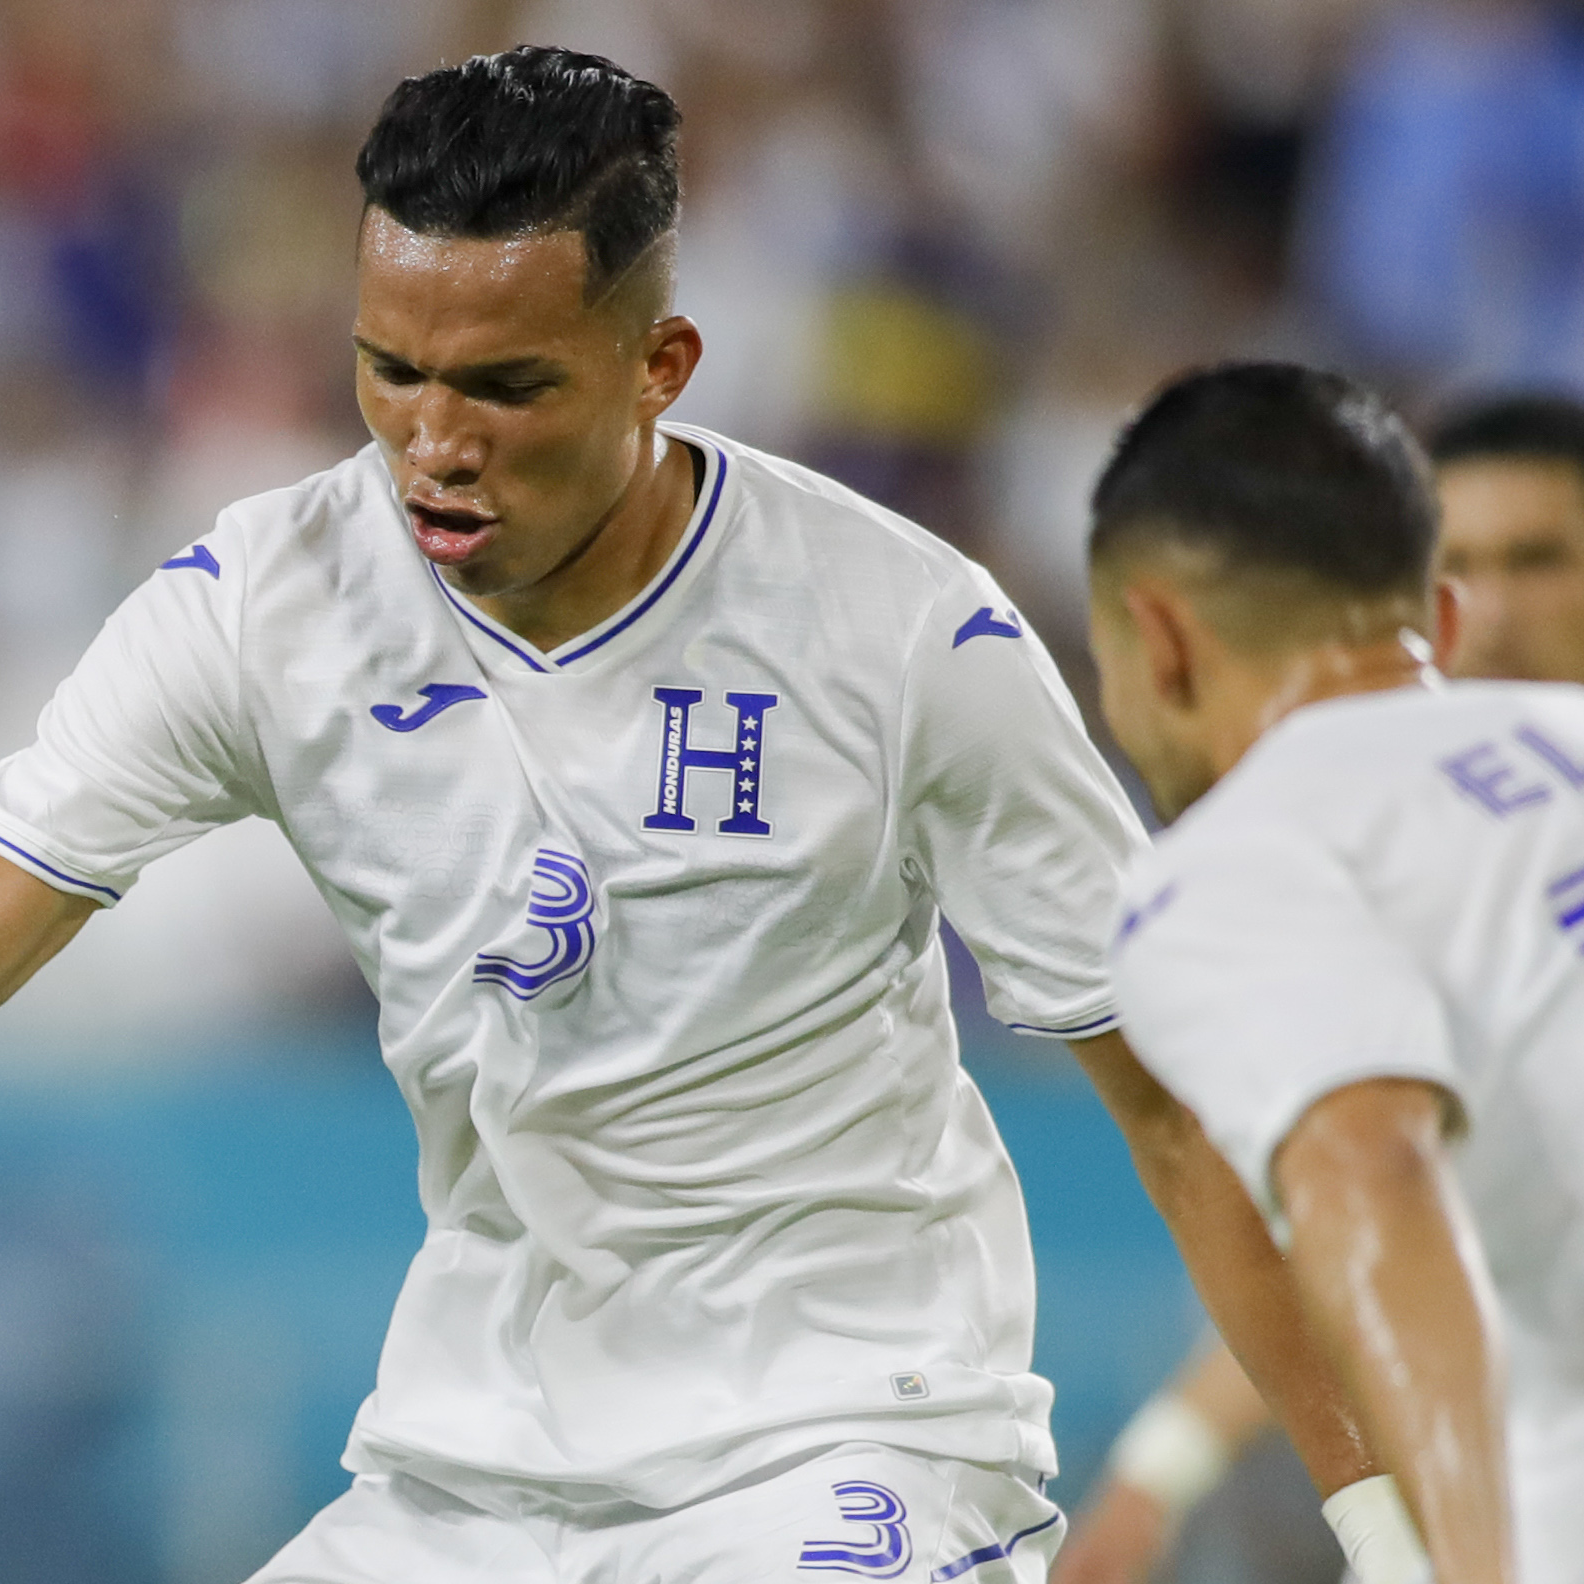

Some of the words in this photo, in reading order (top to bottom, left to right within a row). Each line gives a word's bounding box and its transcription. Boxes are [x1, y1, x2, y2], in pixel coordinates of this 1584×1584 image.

[663, 706, 683, 814] HONDURAS
[472, 848, 597, 1001] 3
[796, 1480, 913, 1580] 3
